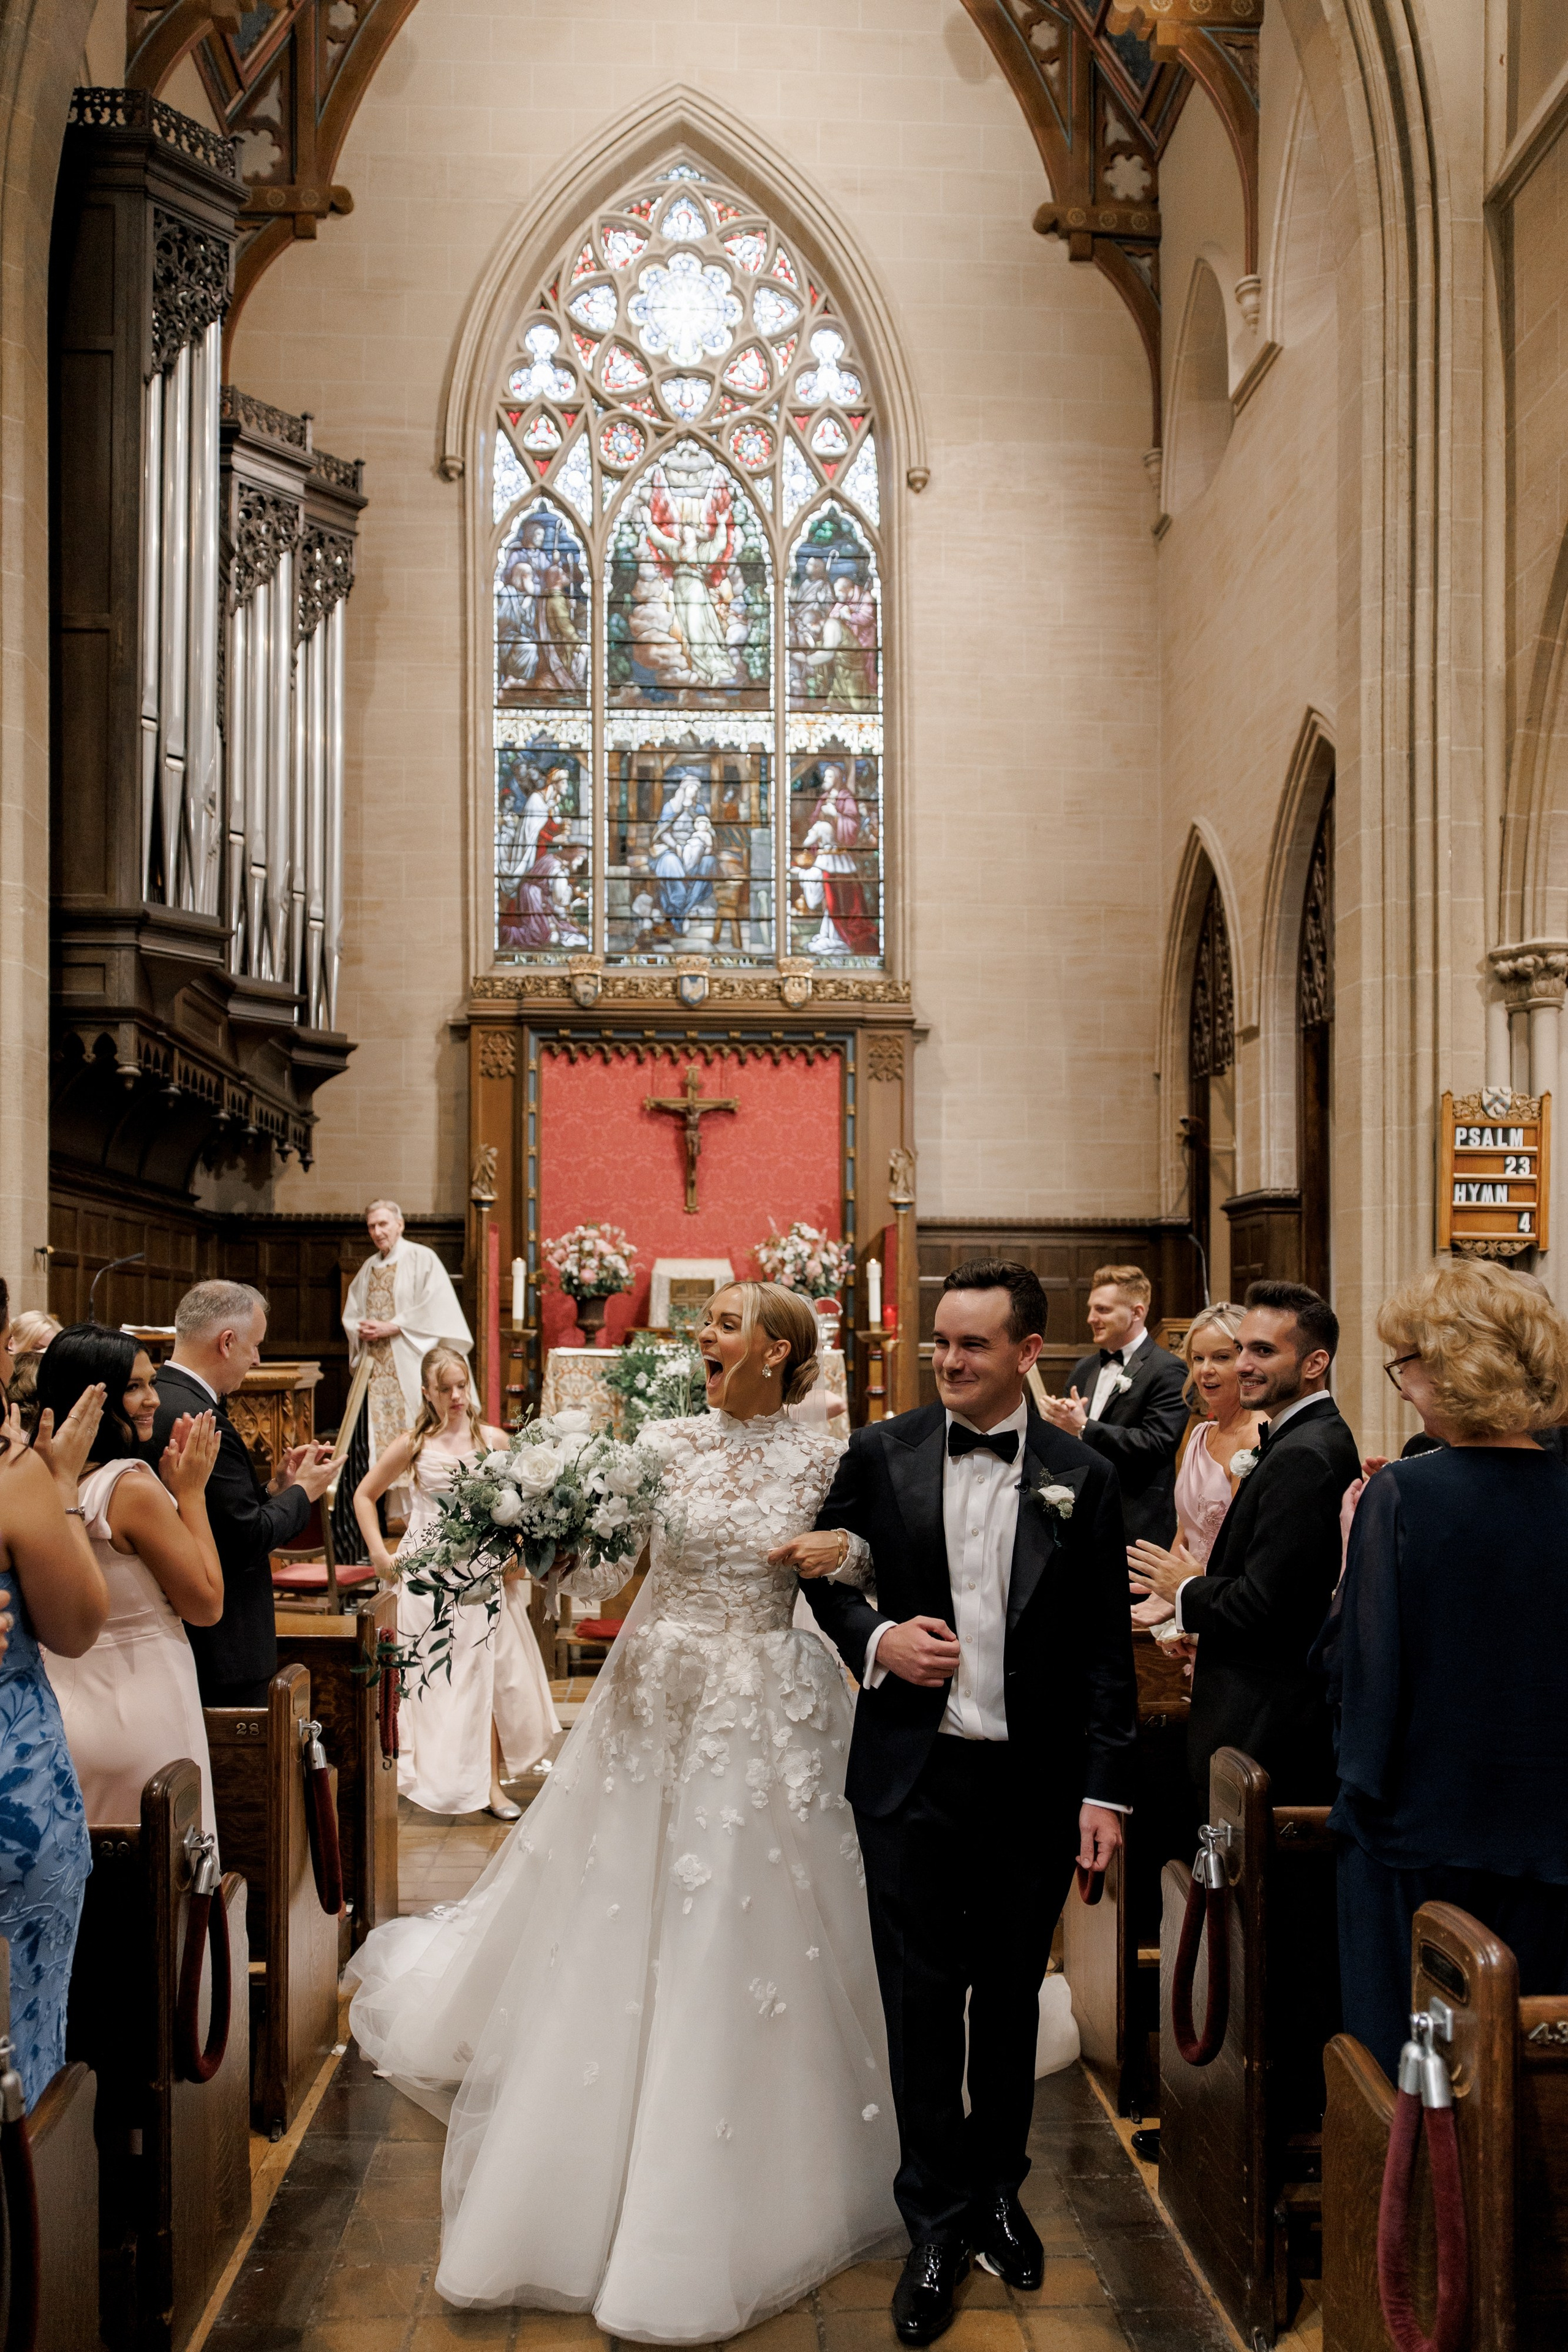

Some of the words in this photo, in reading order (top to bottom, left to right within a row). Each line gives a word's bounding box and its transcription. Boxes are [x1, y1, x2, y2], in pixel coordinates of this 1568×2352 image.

[1455, 1126, 1523, 1147] PSALM
[1505, 1156, 1530, 1175] 23
[1454, 1183, 1507, 1202] HYMN
[1518, 1212, 1530, 1232] 4
[236, 1722, 260, 1736] 28
[1144, 1714, 1167, 1727] 41
[99, 1841, 130, 1858] 29
[1528, 2021, 1568, 2045] 43
